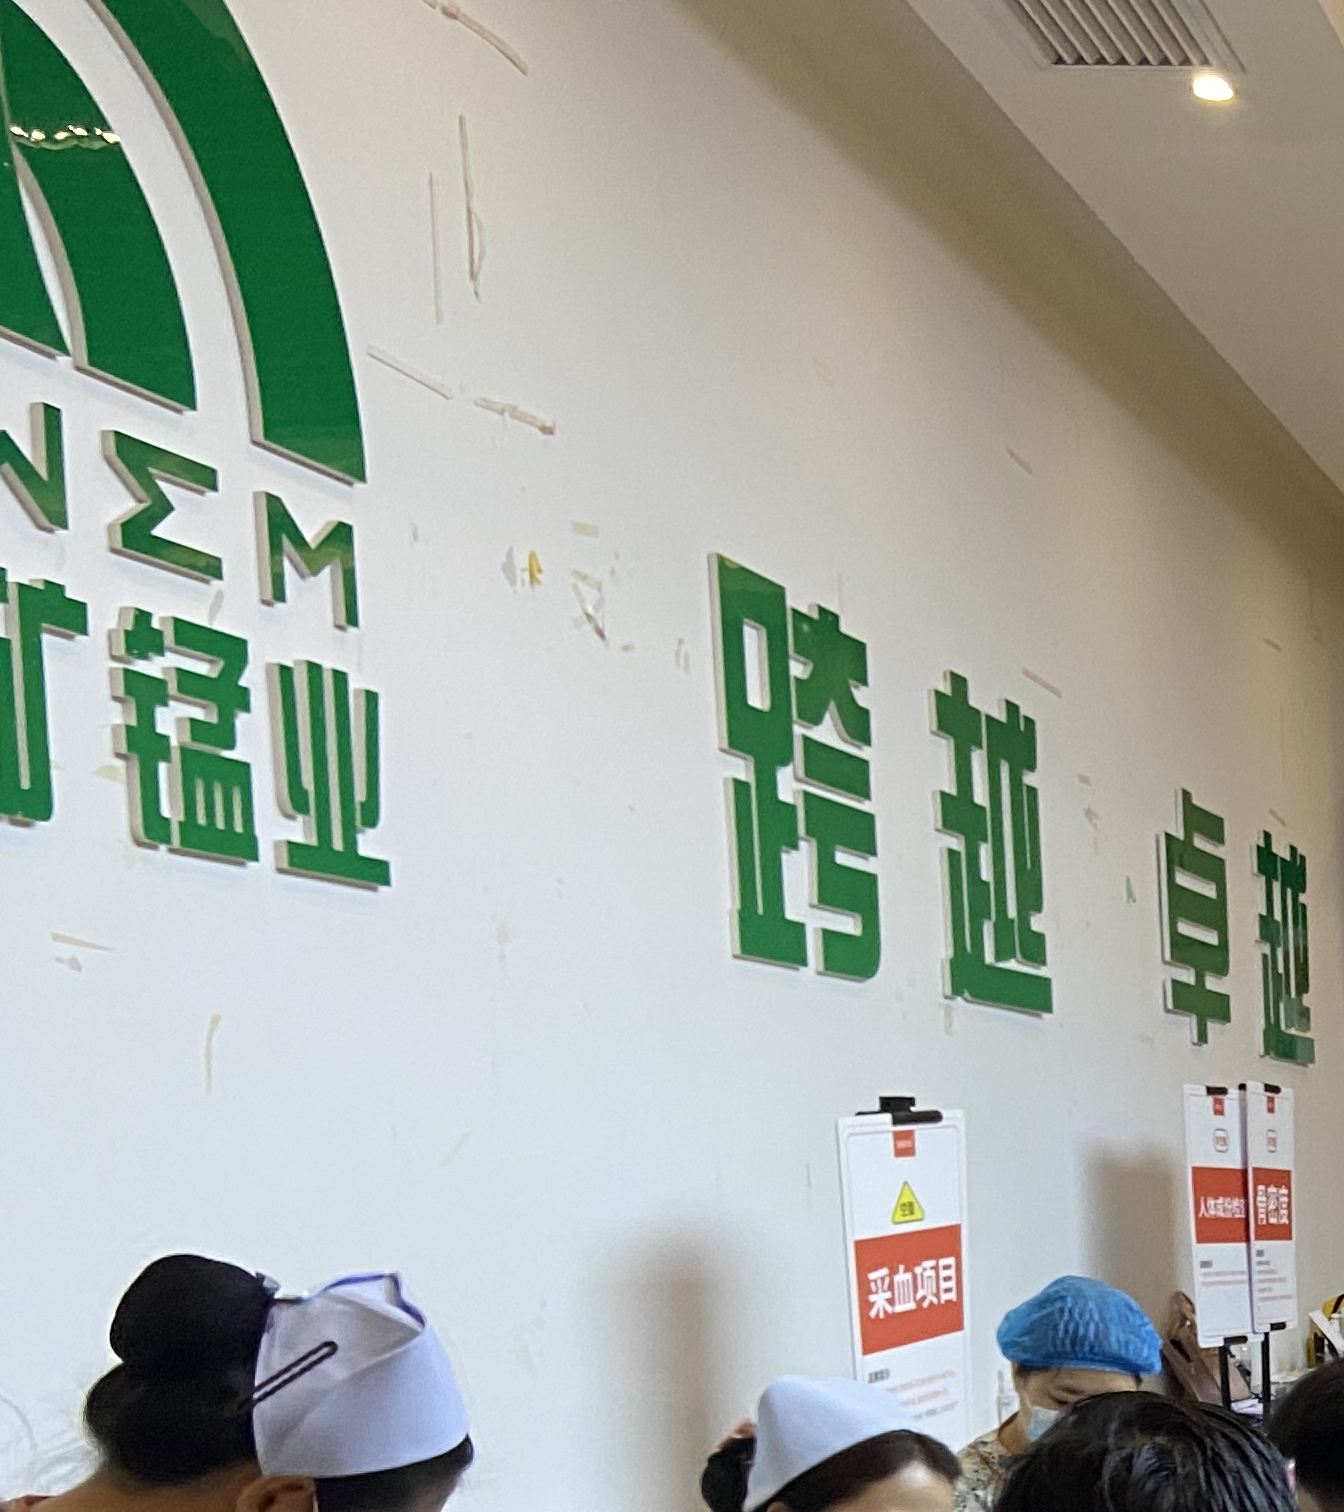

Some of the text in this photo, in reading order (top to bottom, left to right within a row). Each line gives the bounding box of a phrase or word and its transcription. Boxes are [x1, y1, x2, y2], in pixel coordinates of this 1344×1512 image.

[708, 551, 1316, 1066] 跨越 卓越
[867, 1255, 958, 1320] 采血项目
